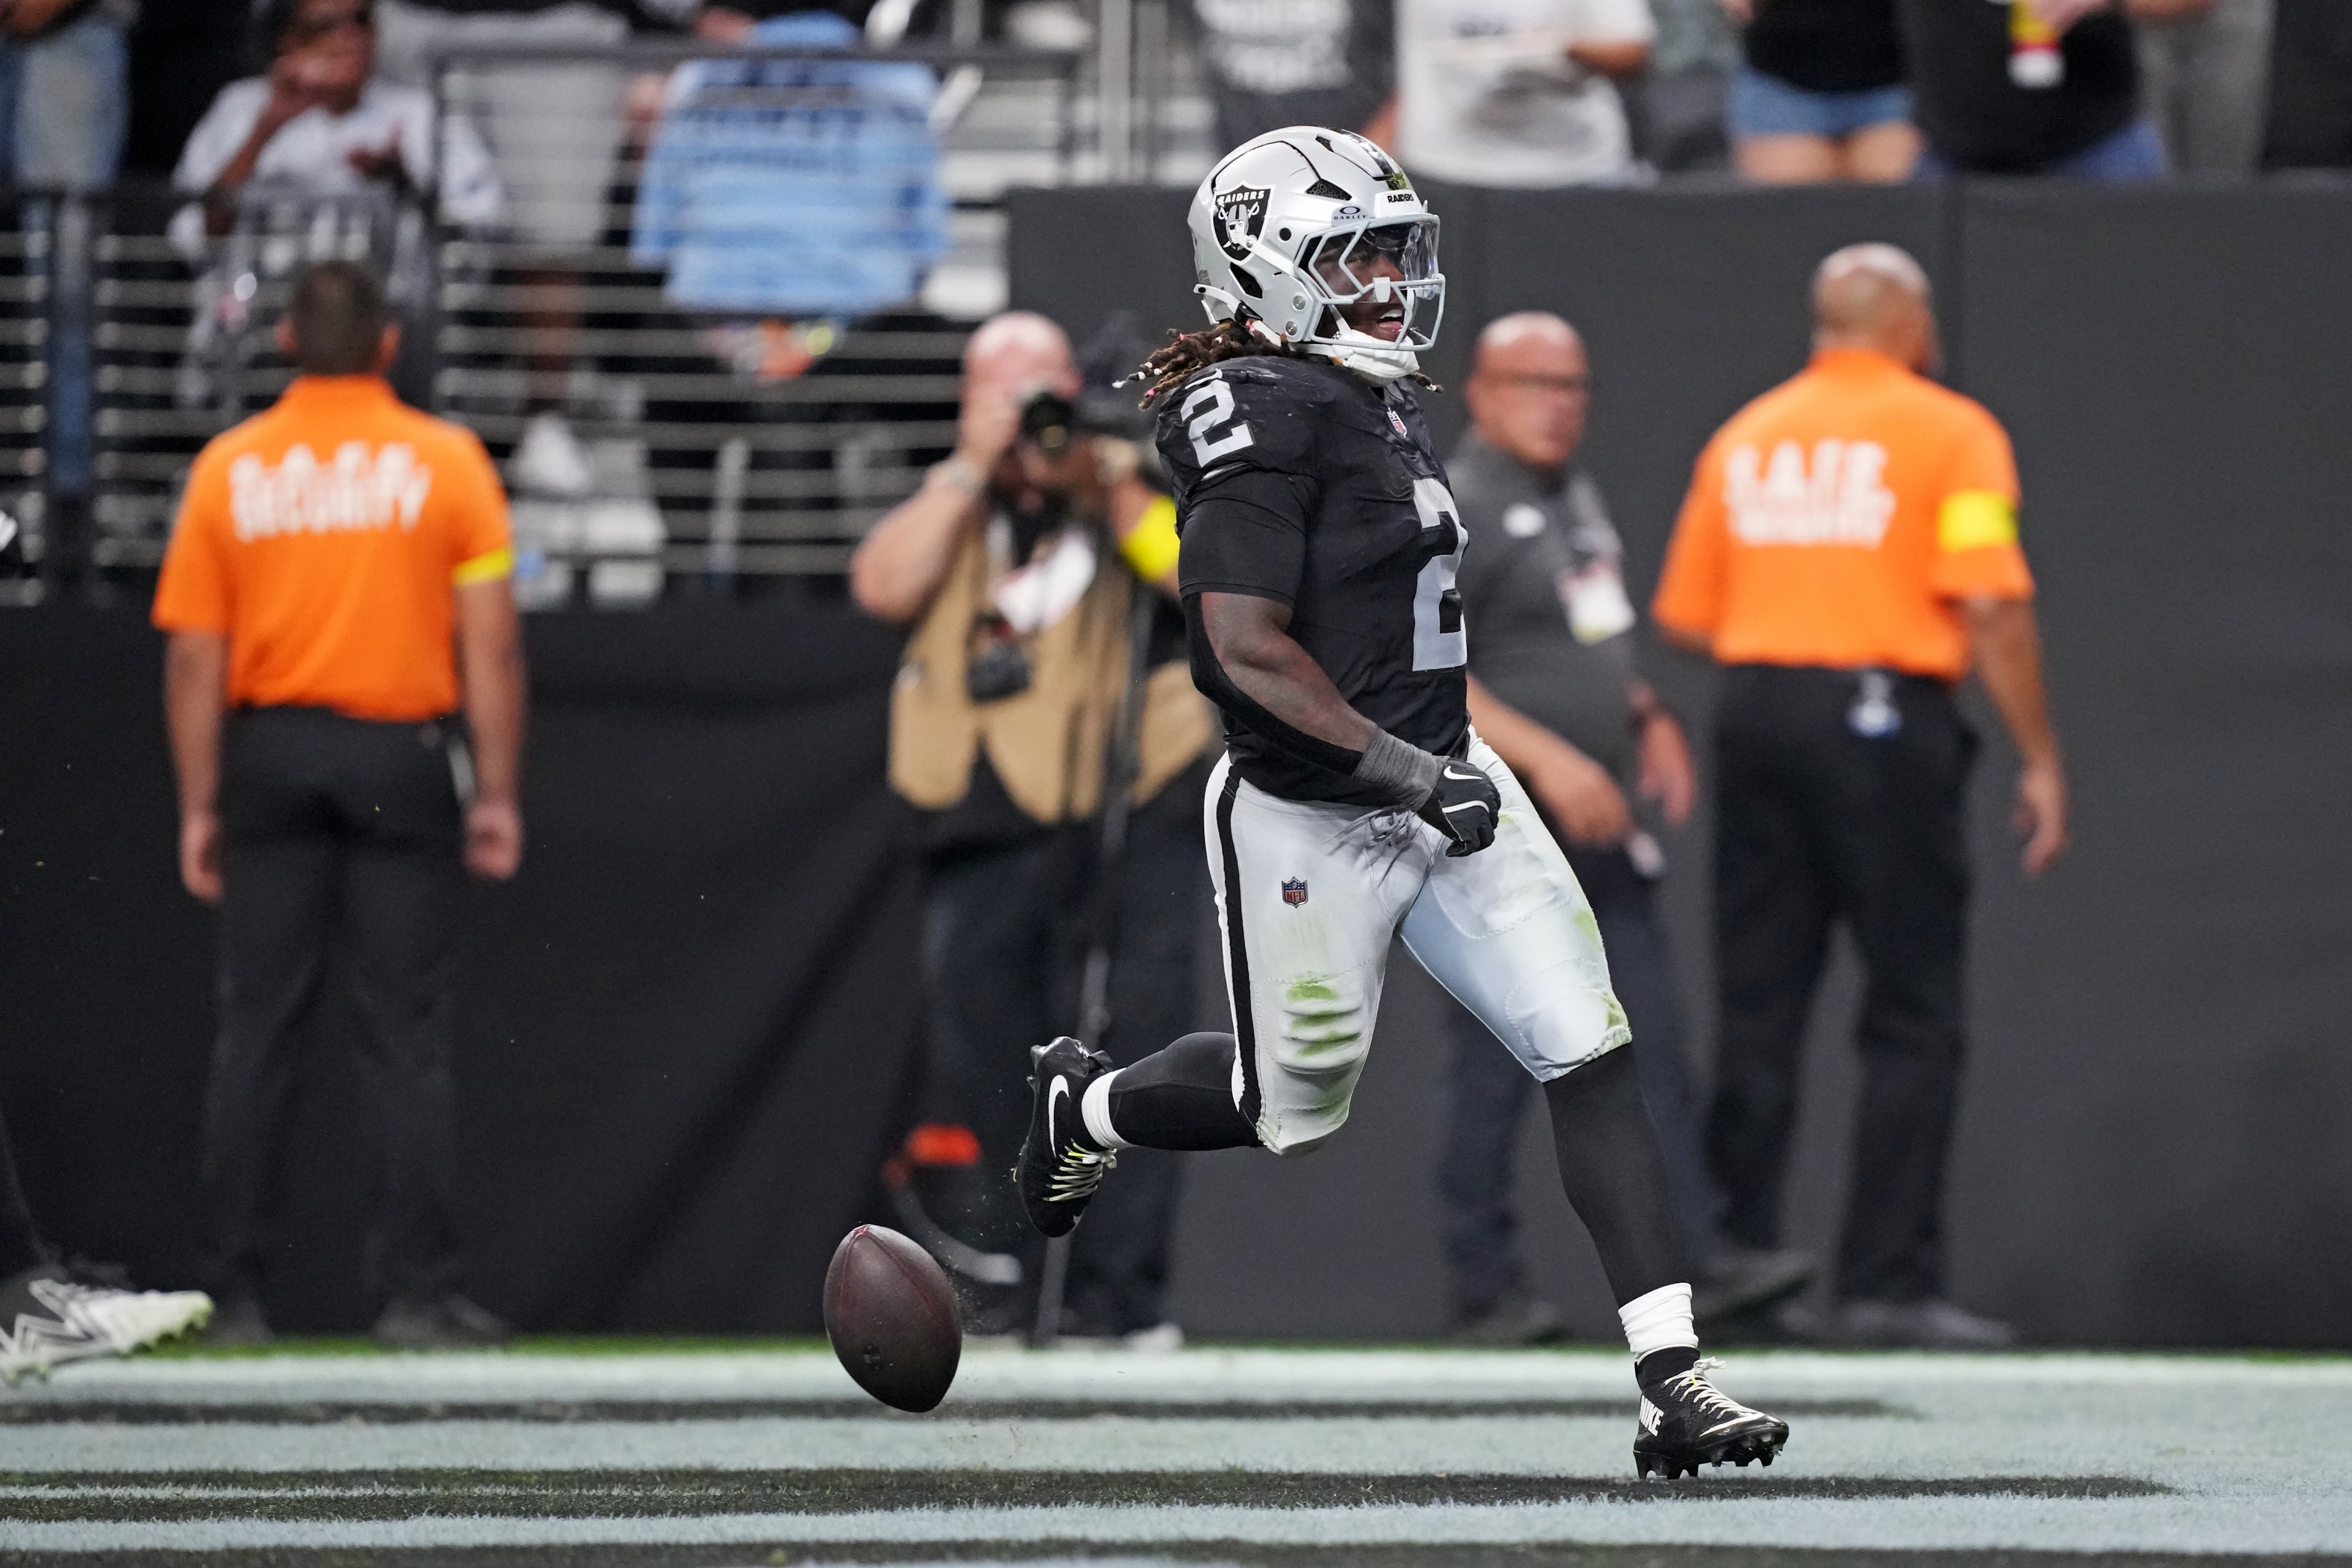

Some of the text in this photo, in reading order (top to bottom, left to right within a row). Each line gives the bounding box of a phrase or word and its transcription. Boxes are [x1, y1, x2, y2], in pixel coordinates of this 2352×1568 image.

[1217, 190, 1264, 206] RAIDERS
[1387, 193, 1414, 203] RAIDERS
[1180, 378, 1254, 468] 2
[1412, 477, 1468, 671] 2
[1286, 891, 1305, 902] NFL
[1639, 1394, 1665, 1437] NIKE
